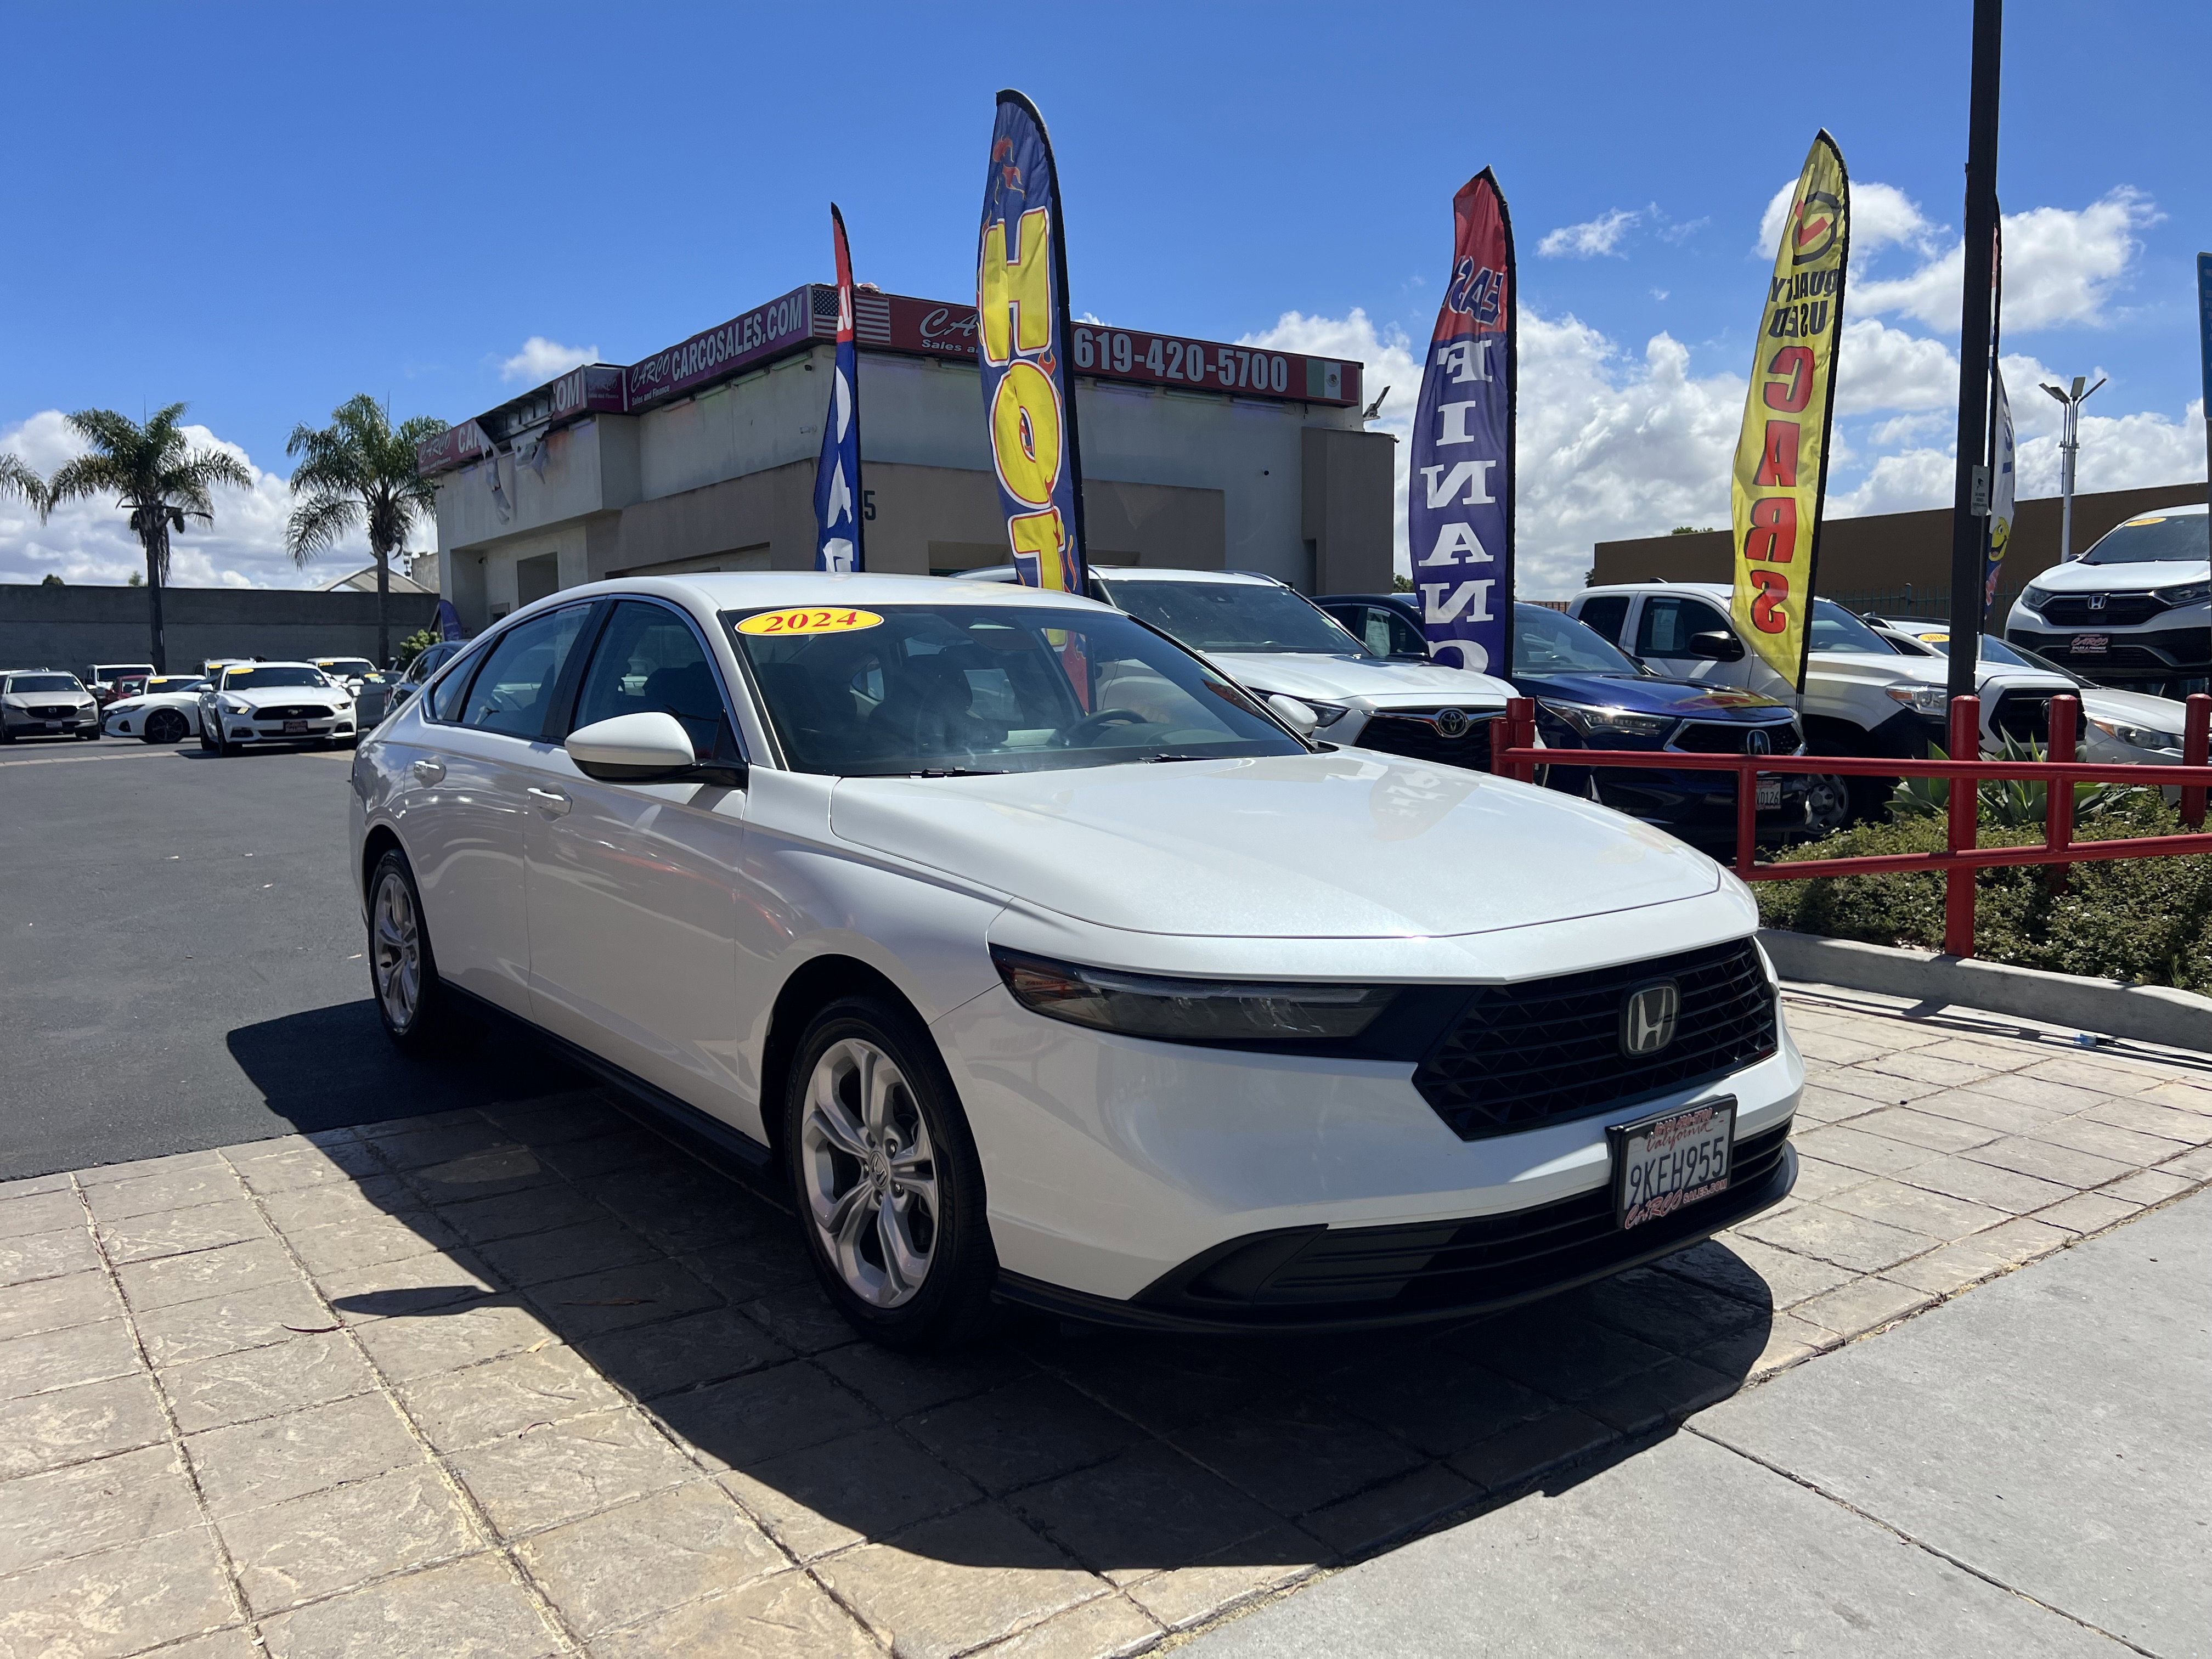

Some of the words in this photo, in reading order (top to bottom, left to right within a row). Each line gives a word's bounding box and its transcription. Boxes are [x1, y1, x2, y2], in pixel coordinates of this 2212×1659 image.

[631, 353, 670, 393] CARCO
[672, 293, 803, 382] CARCOSALES.COM
[922, 338, 962, 352] Sales
[1074, 328, 1288, 392] 619-420-5700
[979, 205, 1065, 596] HOT
[763, 611, 857, 633] 2024
[1647, 1122, 1714, 1152] California
[1683, 1178, 1728, 1204] SALES.COM
